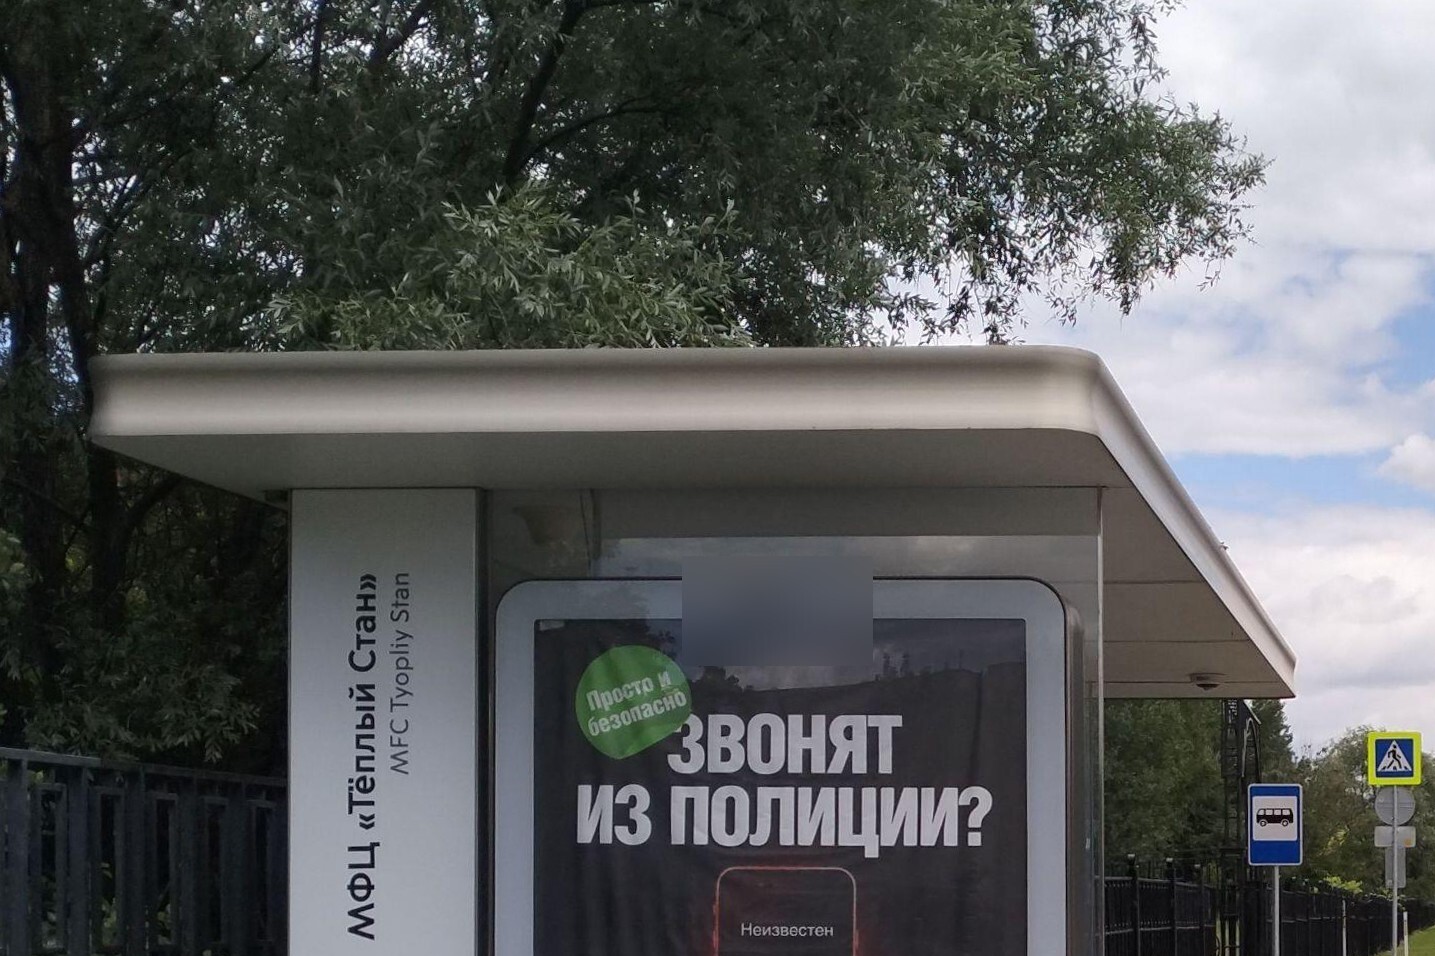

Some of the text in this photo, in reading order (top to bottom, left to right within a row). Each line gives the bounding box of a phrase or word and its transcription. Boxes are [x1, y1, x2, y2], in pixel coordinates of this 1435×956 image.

[389, 573, 414, 774] MFC Tyopliy Stan
[586, 671, 671, 713] Просто и
[588, 688, 687, 737] безопасно
[347, 573, 380, 940] МФЦ «Тёплый Стан»
[667, 713, 903, 776] ЗВОНЯТ
[577, 784, 994, 859] ИЗ ПОЛИЦИИ?
[740, 921, 834, 938] Неизвестен
